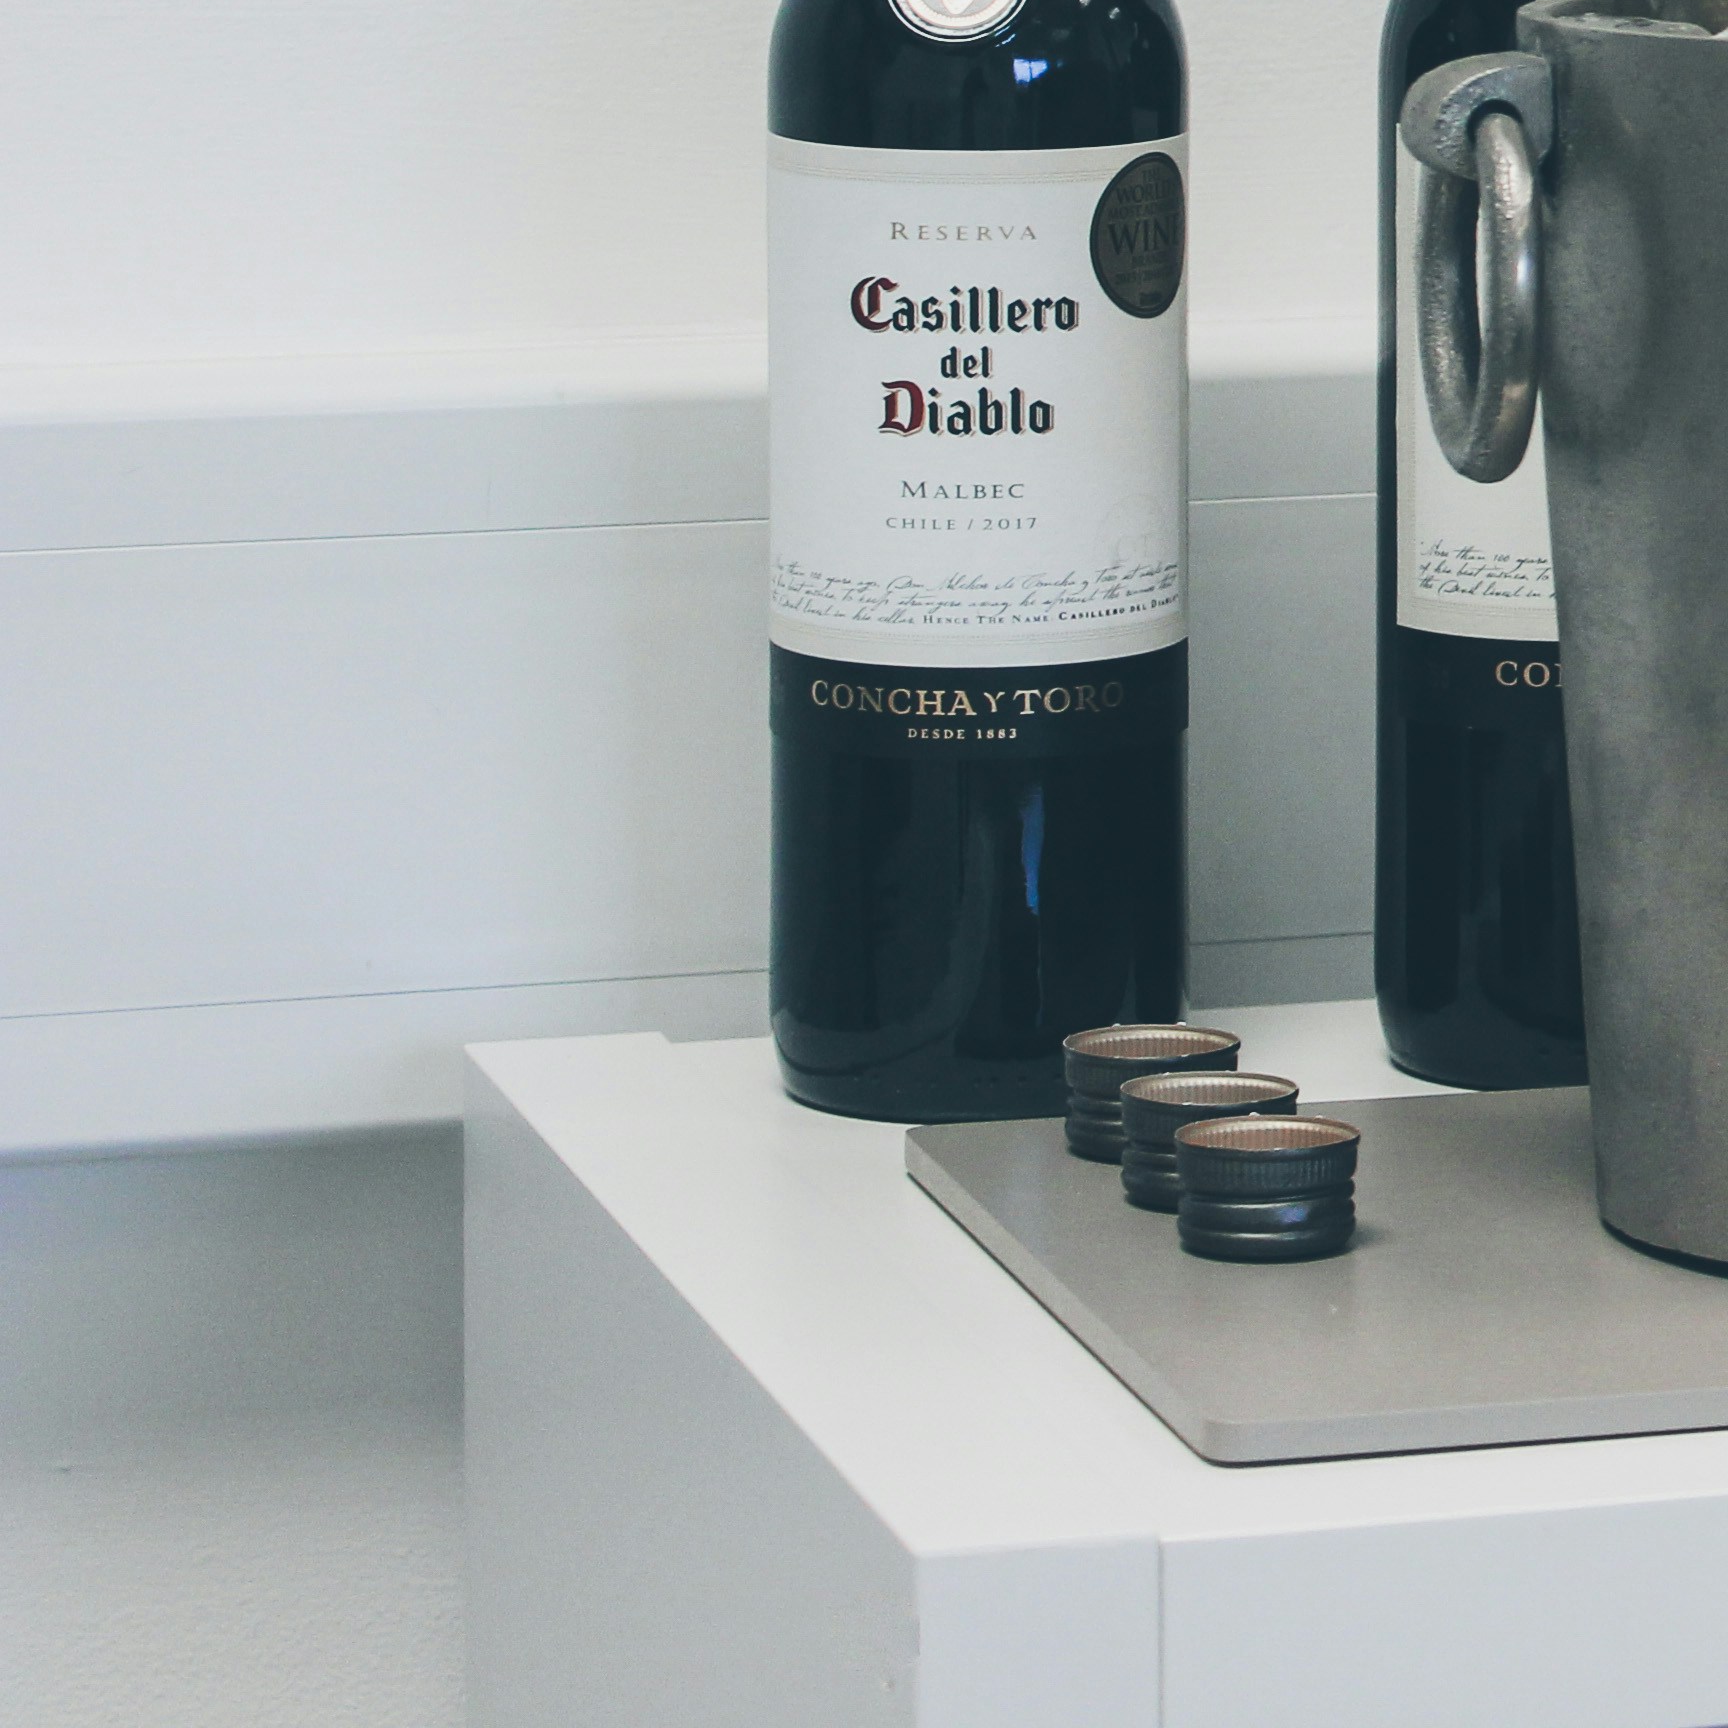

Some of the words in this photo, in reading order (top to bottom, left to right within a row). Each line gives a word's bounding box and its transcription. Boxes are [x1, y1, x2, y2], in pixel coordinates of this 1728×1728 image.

[891, 221, 1038, 241] RESERVA
[850, 275, 1080, 334] Casillero
[940, 345, 993, 380] del
[878, 379, 1055, 437] Diablo
[901, 480, 1026, 500] MALBEC
[886, 516, 957, 531] CHILE
[983, 516, 1038, 531] 2017
[811, 679, 978, 716] CONCHA
[983, 690, 1006, 714] Y
[1012, 680, 1124, 716] TORO
[907, 727, 966, 740] DESDE
[976, 727, 1018, 741] 1883
